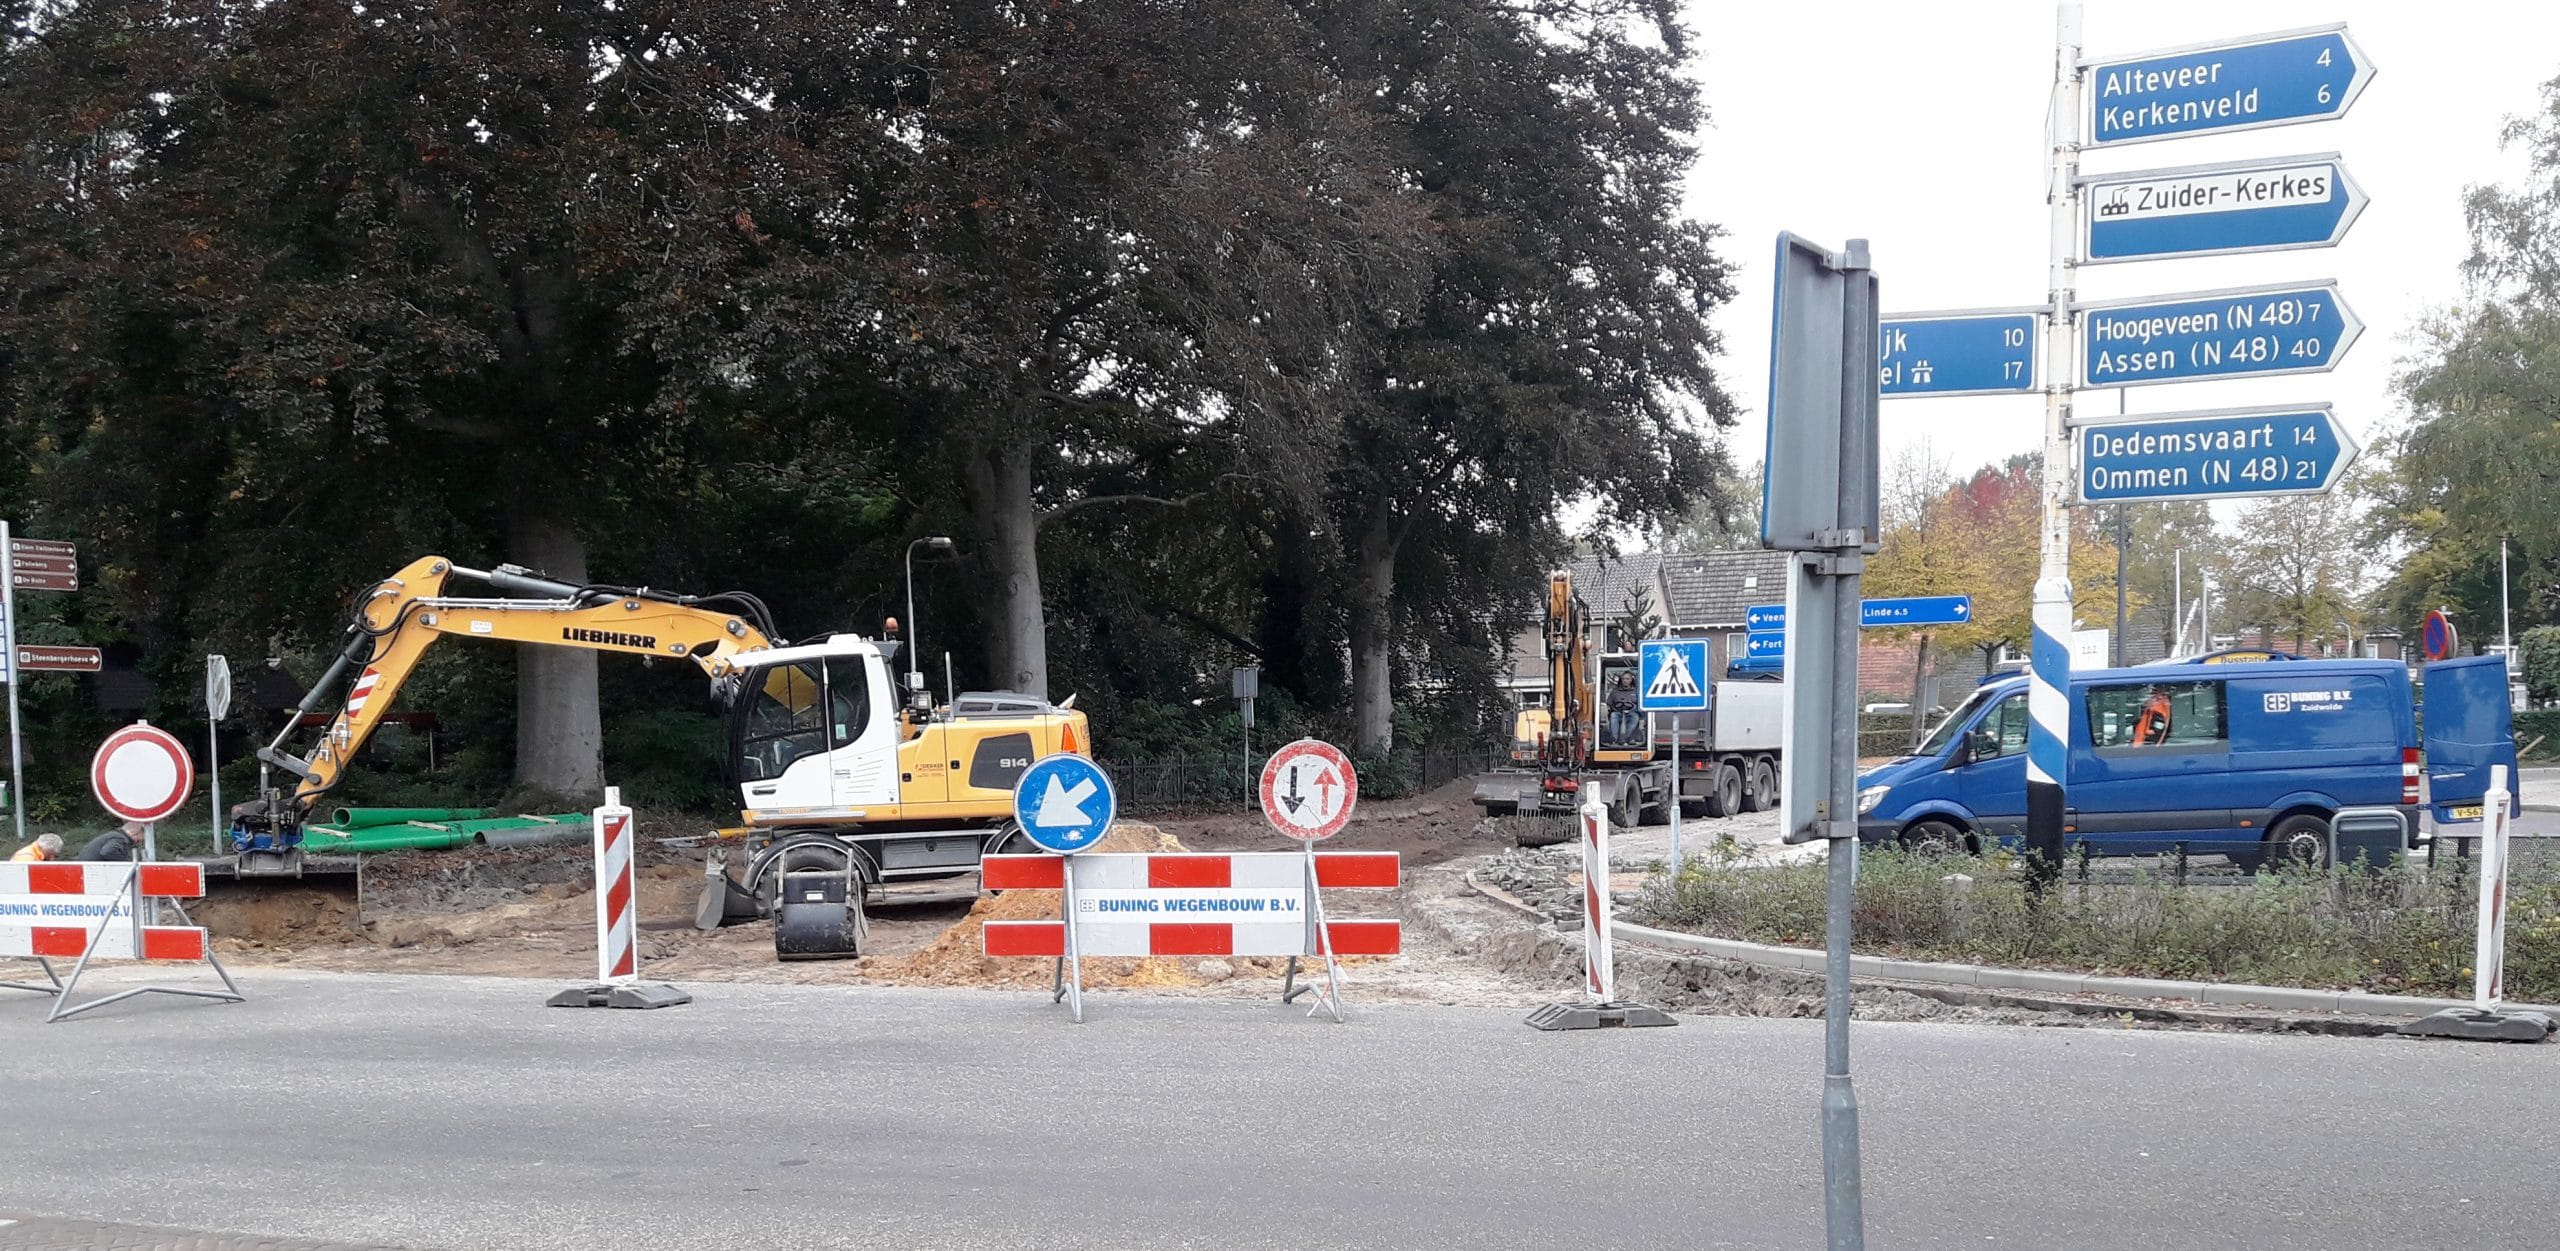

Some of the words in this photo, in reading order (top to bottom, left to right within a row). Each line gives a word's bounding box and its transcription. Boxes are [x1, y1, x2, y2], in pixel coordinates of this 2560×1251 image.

[2103, 62, 2222, 97] Alteveer
[2316, 47, 2332, 68] 4
[2104, 88, 2258, 132] Kerkenveld
[2317, 83, 2331, 104] 6
[2137, 175, 2325, 211] Zuider-Kerkes
[2096, 312, 2218, 345] Hoogeveen
[2308, 303, 2321, 322] 7
[2003, 328, 2024, 347] 10
[2095, 349, 2175, 375] Assen
[2291, 338, 2320, 358] 40
[2003, 361, 2024, 381] 17
[2092, 423, 2273, 457] Dedemsvaart
[2293, 426, 2317, 446] 14
[2091, 466, 2188, 490] Ommen
[2296, 461, 2317, 480] 21
[1864, 607, 1892, 617] Linde
[1894, 607, 1908, 616] 6.5
[562, 627, 657, 648] LIEBHERR
[1762, 640, 1782, 648] Fort
[2291, 691, 2331, 702] BUNING
[2333, 690, 2352, 701] B.V.
[2301, 703, 2343, 712] Zuidwolde
[1000, 757, 1028, 768] 914
[1099, 899, 1159, 912] BUNING
[1164, 899, 1265, 911] WEGENBOUW
[1270, 898, 1300, 911] B.V.
